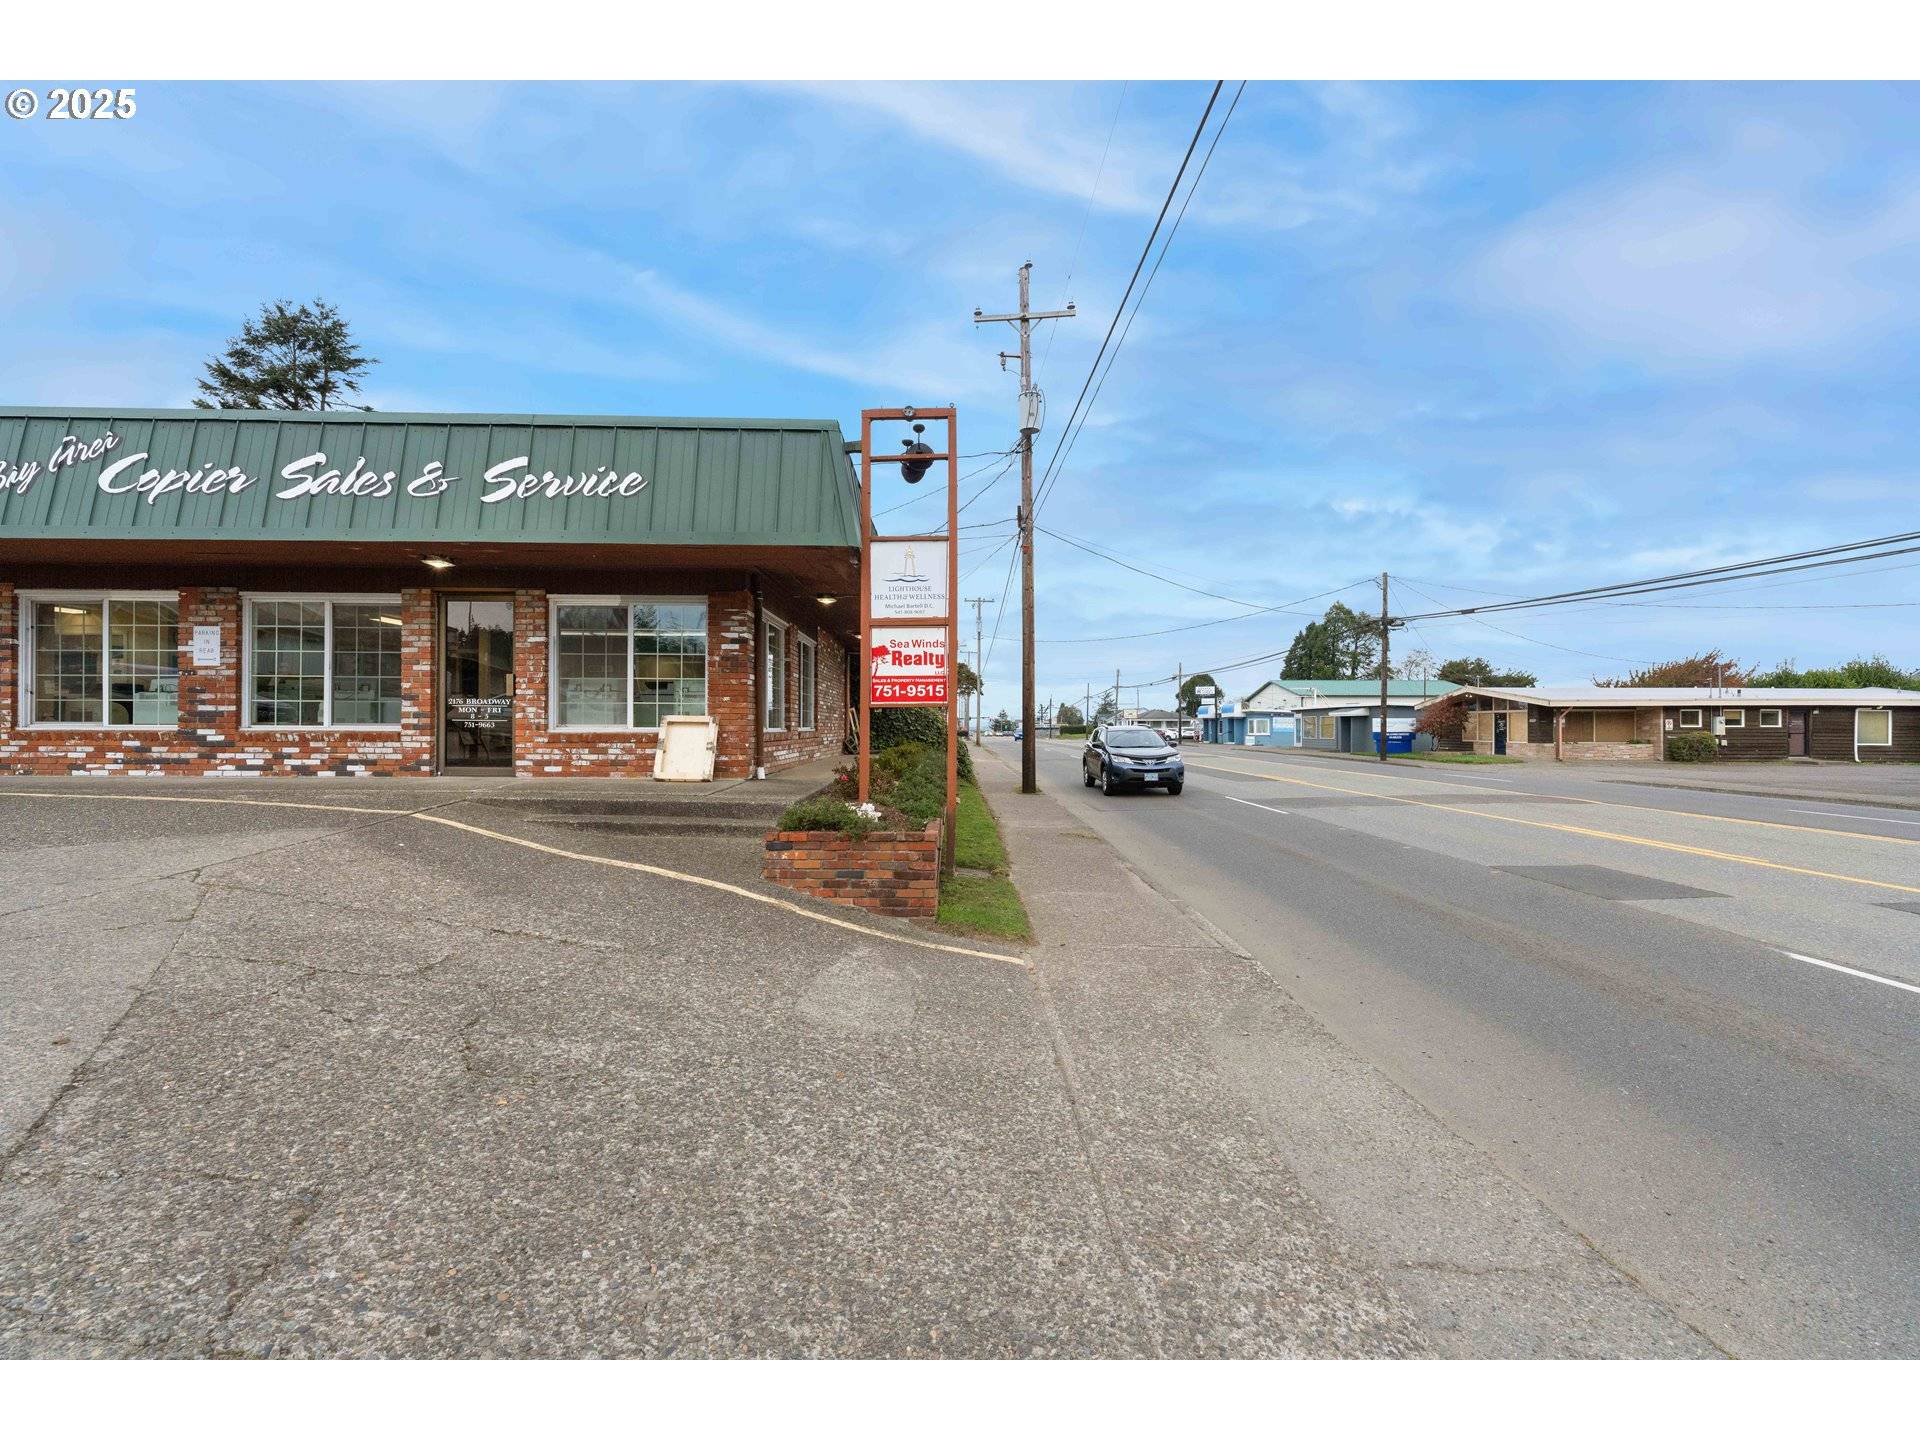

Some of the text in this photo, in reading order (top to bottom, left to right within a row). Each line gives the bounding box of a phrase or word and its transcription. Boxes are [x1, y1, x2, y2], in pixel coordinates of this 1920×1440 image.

[98, 452, 648, 504] Copier Sales & Service
[889, 639, 946, 649] Sea Winds
[891, 650, 945, 669] Realty
[873, 684, 945, 697] 751-9515
